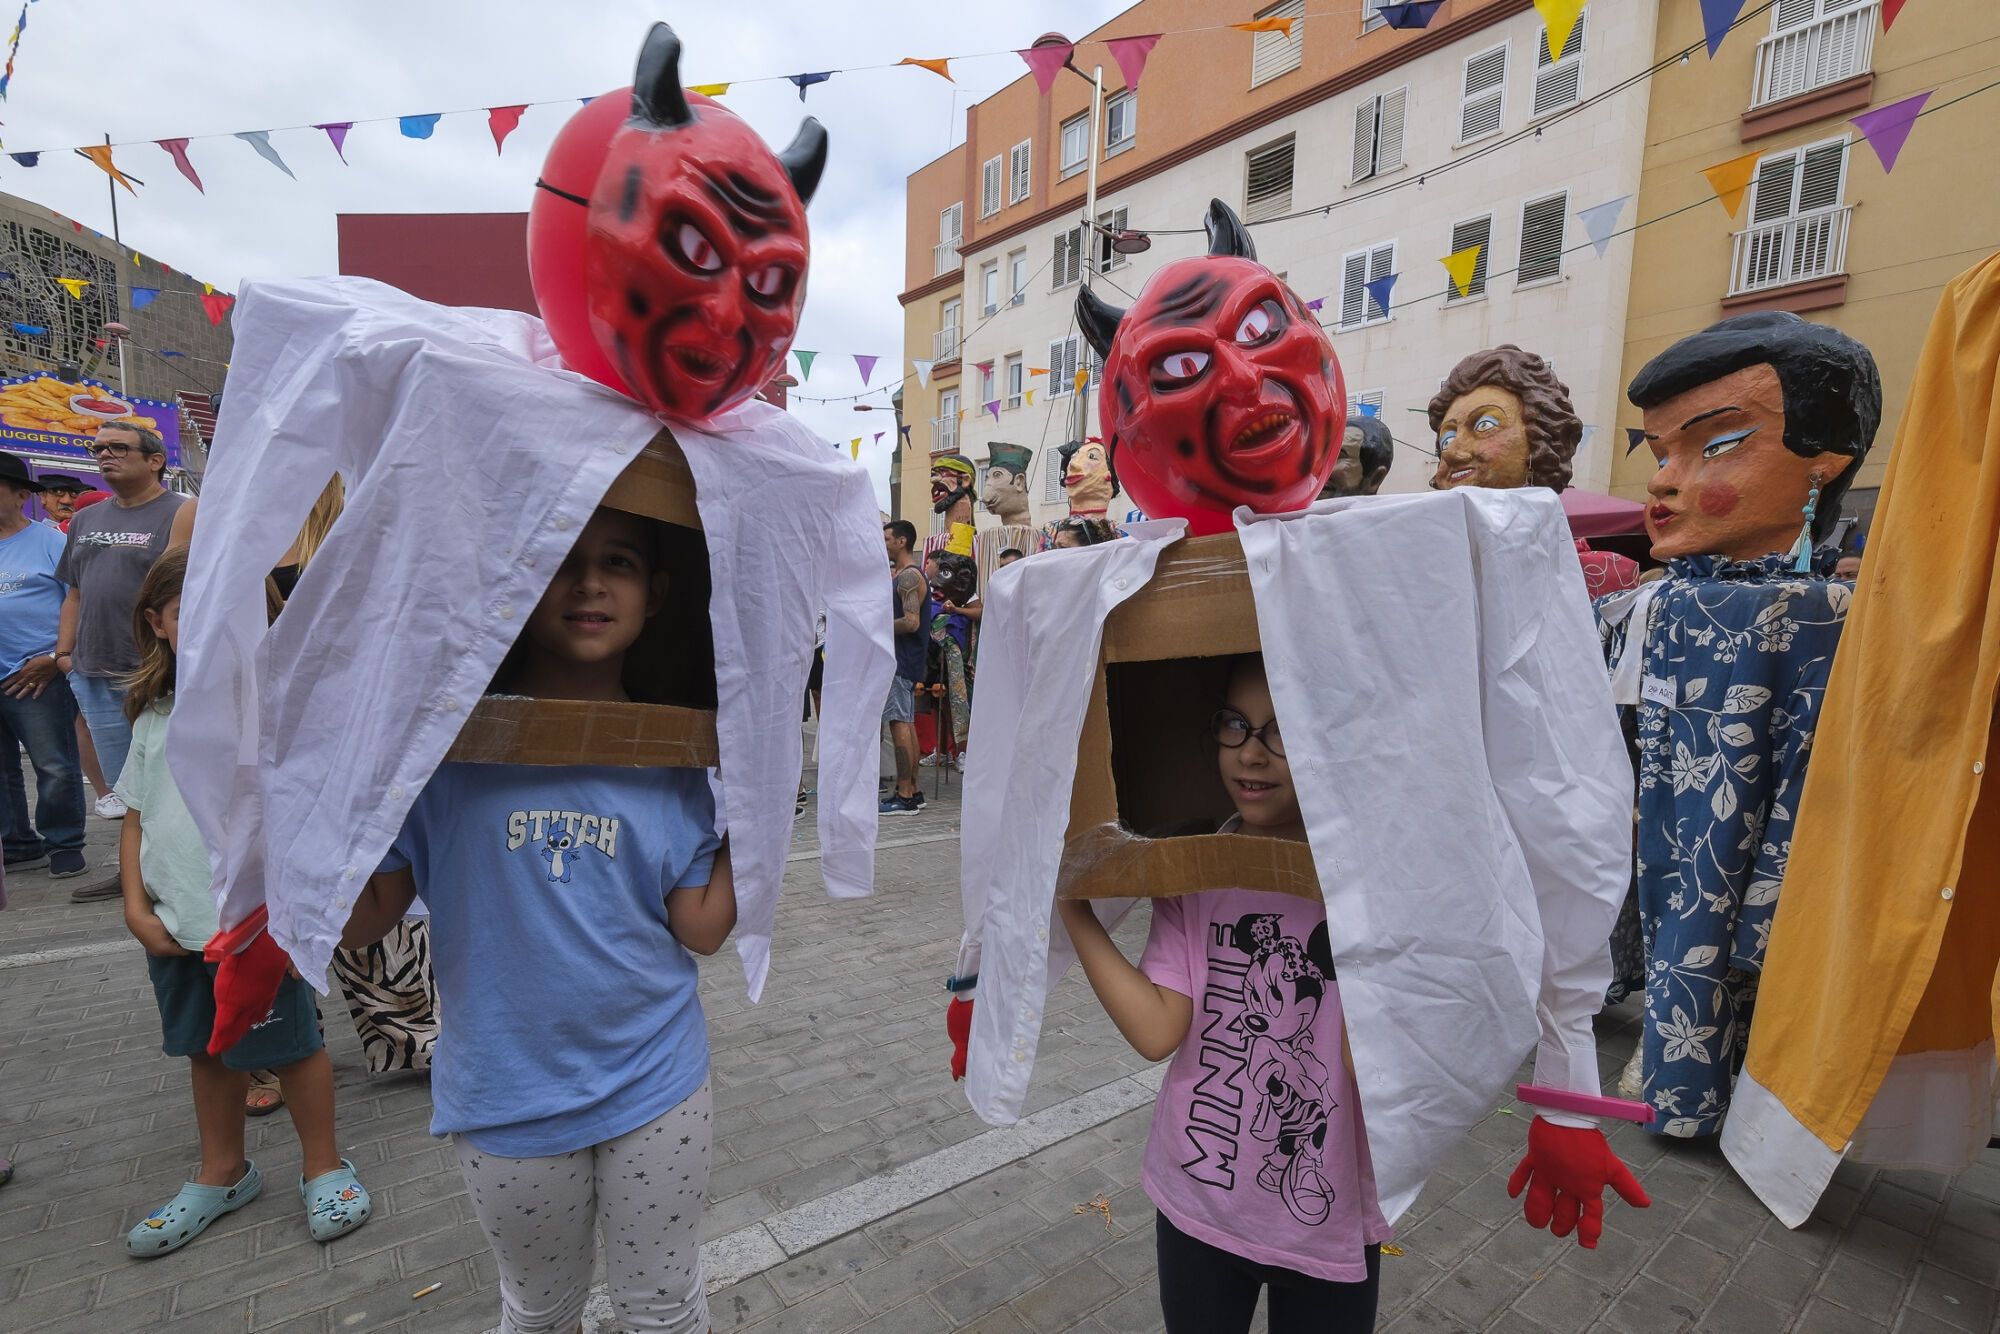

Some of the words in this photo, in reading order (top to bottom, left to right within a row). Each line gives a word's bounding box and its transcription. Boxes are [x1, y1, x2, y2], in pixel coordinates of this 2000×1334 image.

[0, 429, 69, 446] UGGETS
[72, 438, 96, 448] CO
[1181, 920, 1253, 1191] MINNIE
